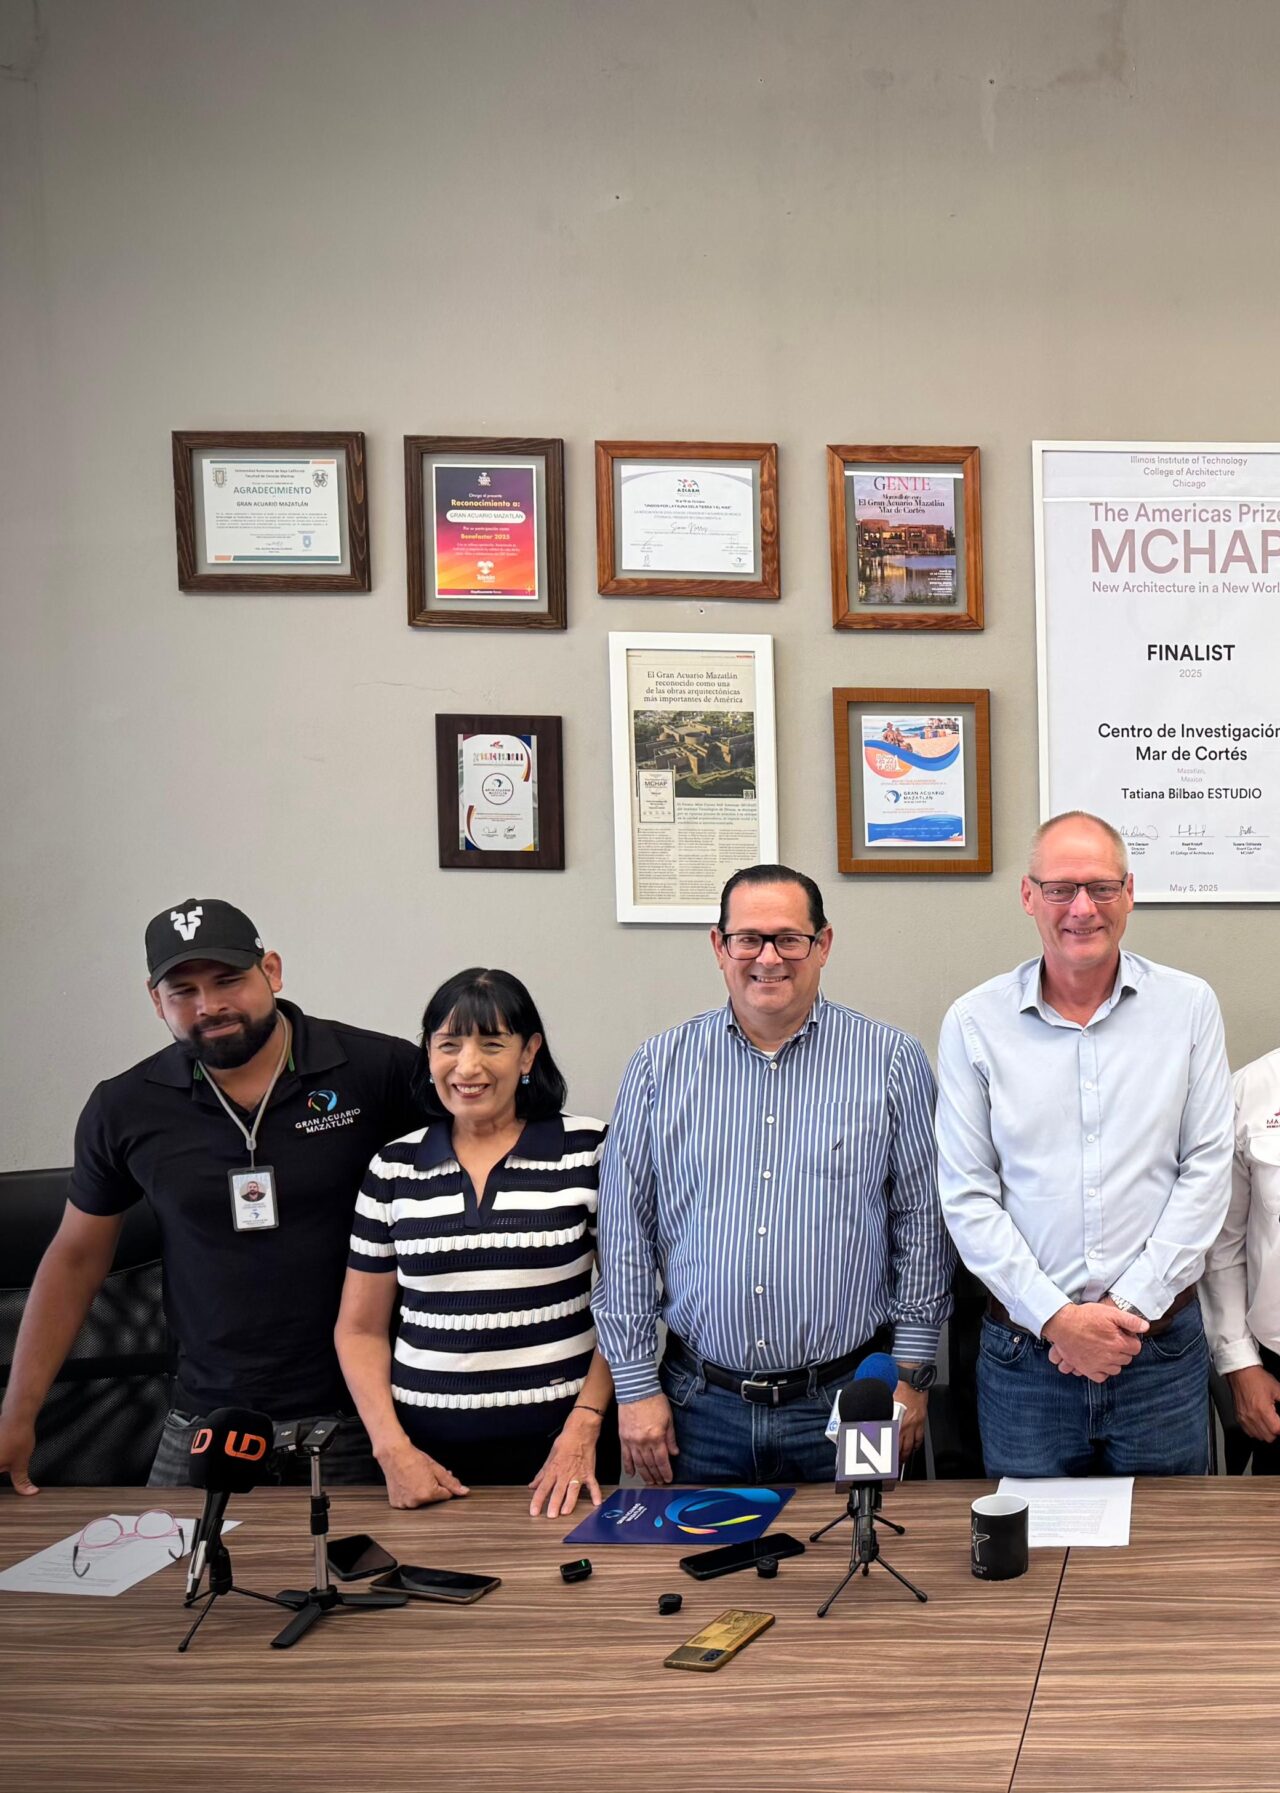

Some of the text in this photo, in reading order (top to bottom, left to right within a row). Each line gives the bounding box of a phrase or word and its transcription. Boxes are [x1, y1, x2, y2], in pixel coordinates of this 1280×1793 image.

[1130, 456, 1247, 467] Illinois Institute of Technology
[1143, 467, 1235, 477] College of Architecture
[874, 476, 931, 491] GENTE
[1172, 479, 1206, 489] Chicago
[234, 486, 312, 494] AGRADECIMIENTO
[451, 499, 510, 507] Reconocimiento
[915, 499, 945, 507] Mazatlán
[903, 506, 926, 514] Cortés
[1089, 502, 1129, 522] The
[1135, 502, 1232, 523] Americas
[1092, 582, 1119, 593] New
[1123, 581, 1195, 593] Architecture
[1199, 581, 1209, 593] in
[1211, 585, 1219, 593] a
[1222, 582, 1249, 593] New
[1147, 644, 1236, 661] FINALIST
[705, 671, 738, 680] Mazatlán
[1179, 669, 1202, 678] 2025
[687, 687, 740, 696] arquitectónicas
[660, 696, 701, 704] importantes
[1098, 723, 1153, 738] Centro
[1157, 723, 1176, 738] de
[1136, 746, 1247, 761] Mar de Cortés
[1121, 788, 1262, 799] Tatiana Bilbao ESTUDIO
[1170, 884, 1187, 893] May
[1190, 884, 1196, 892] 5,
[295, 1108, 361, 1129] GRAN ACUARIO
[306, 1117, 354, 1134] MAZATLÁN
[845, 1427, 892, 1475] LN
